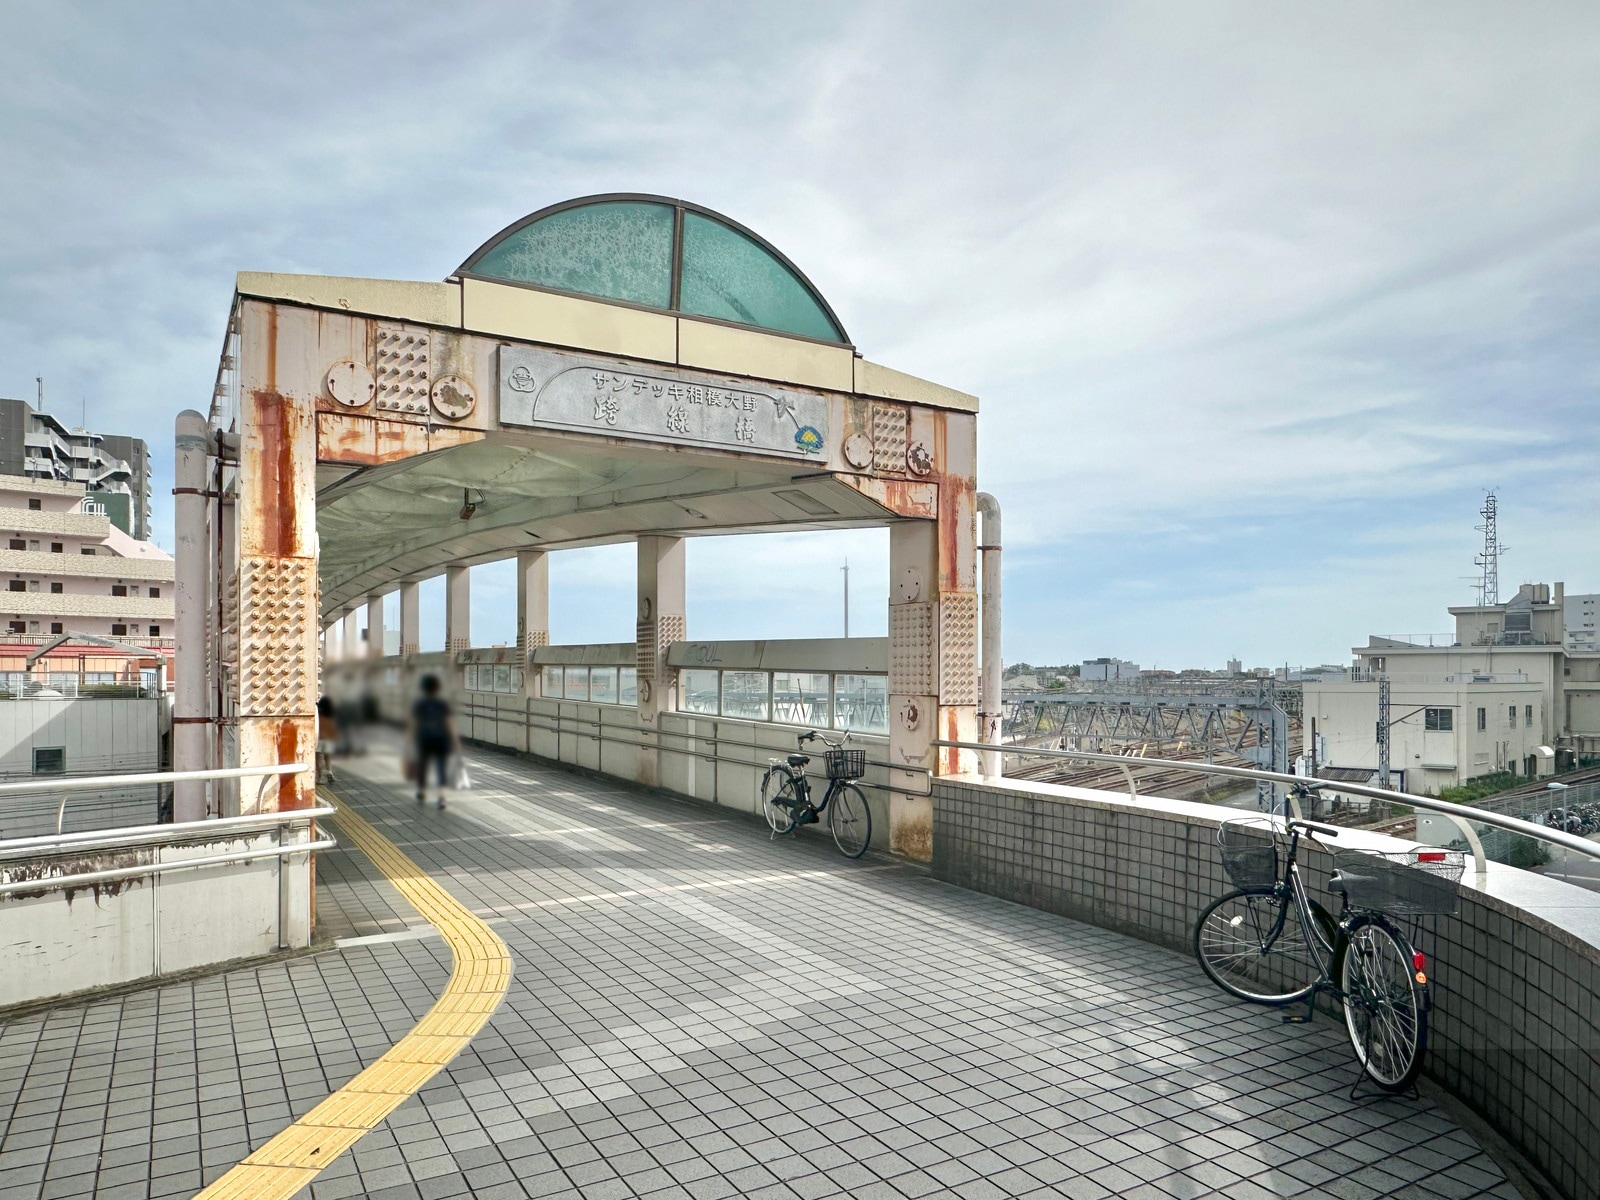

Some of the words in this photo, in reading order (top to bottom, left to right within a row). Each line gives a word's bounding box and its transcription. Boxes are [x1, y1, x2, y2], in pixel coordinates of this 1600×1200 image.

[593, 372, 758, 412] サンデッキ相模大野
